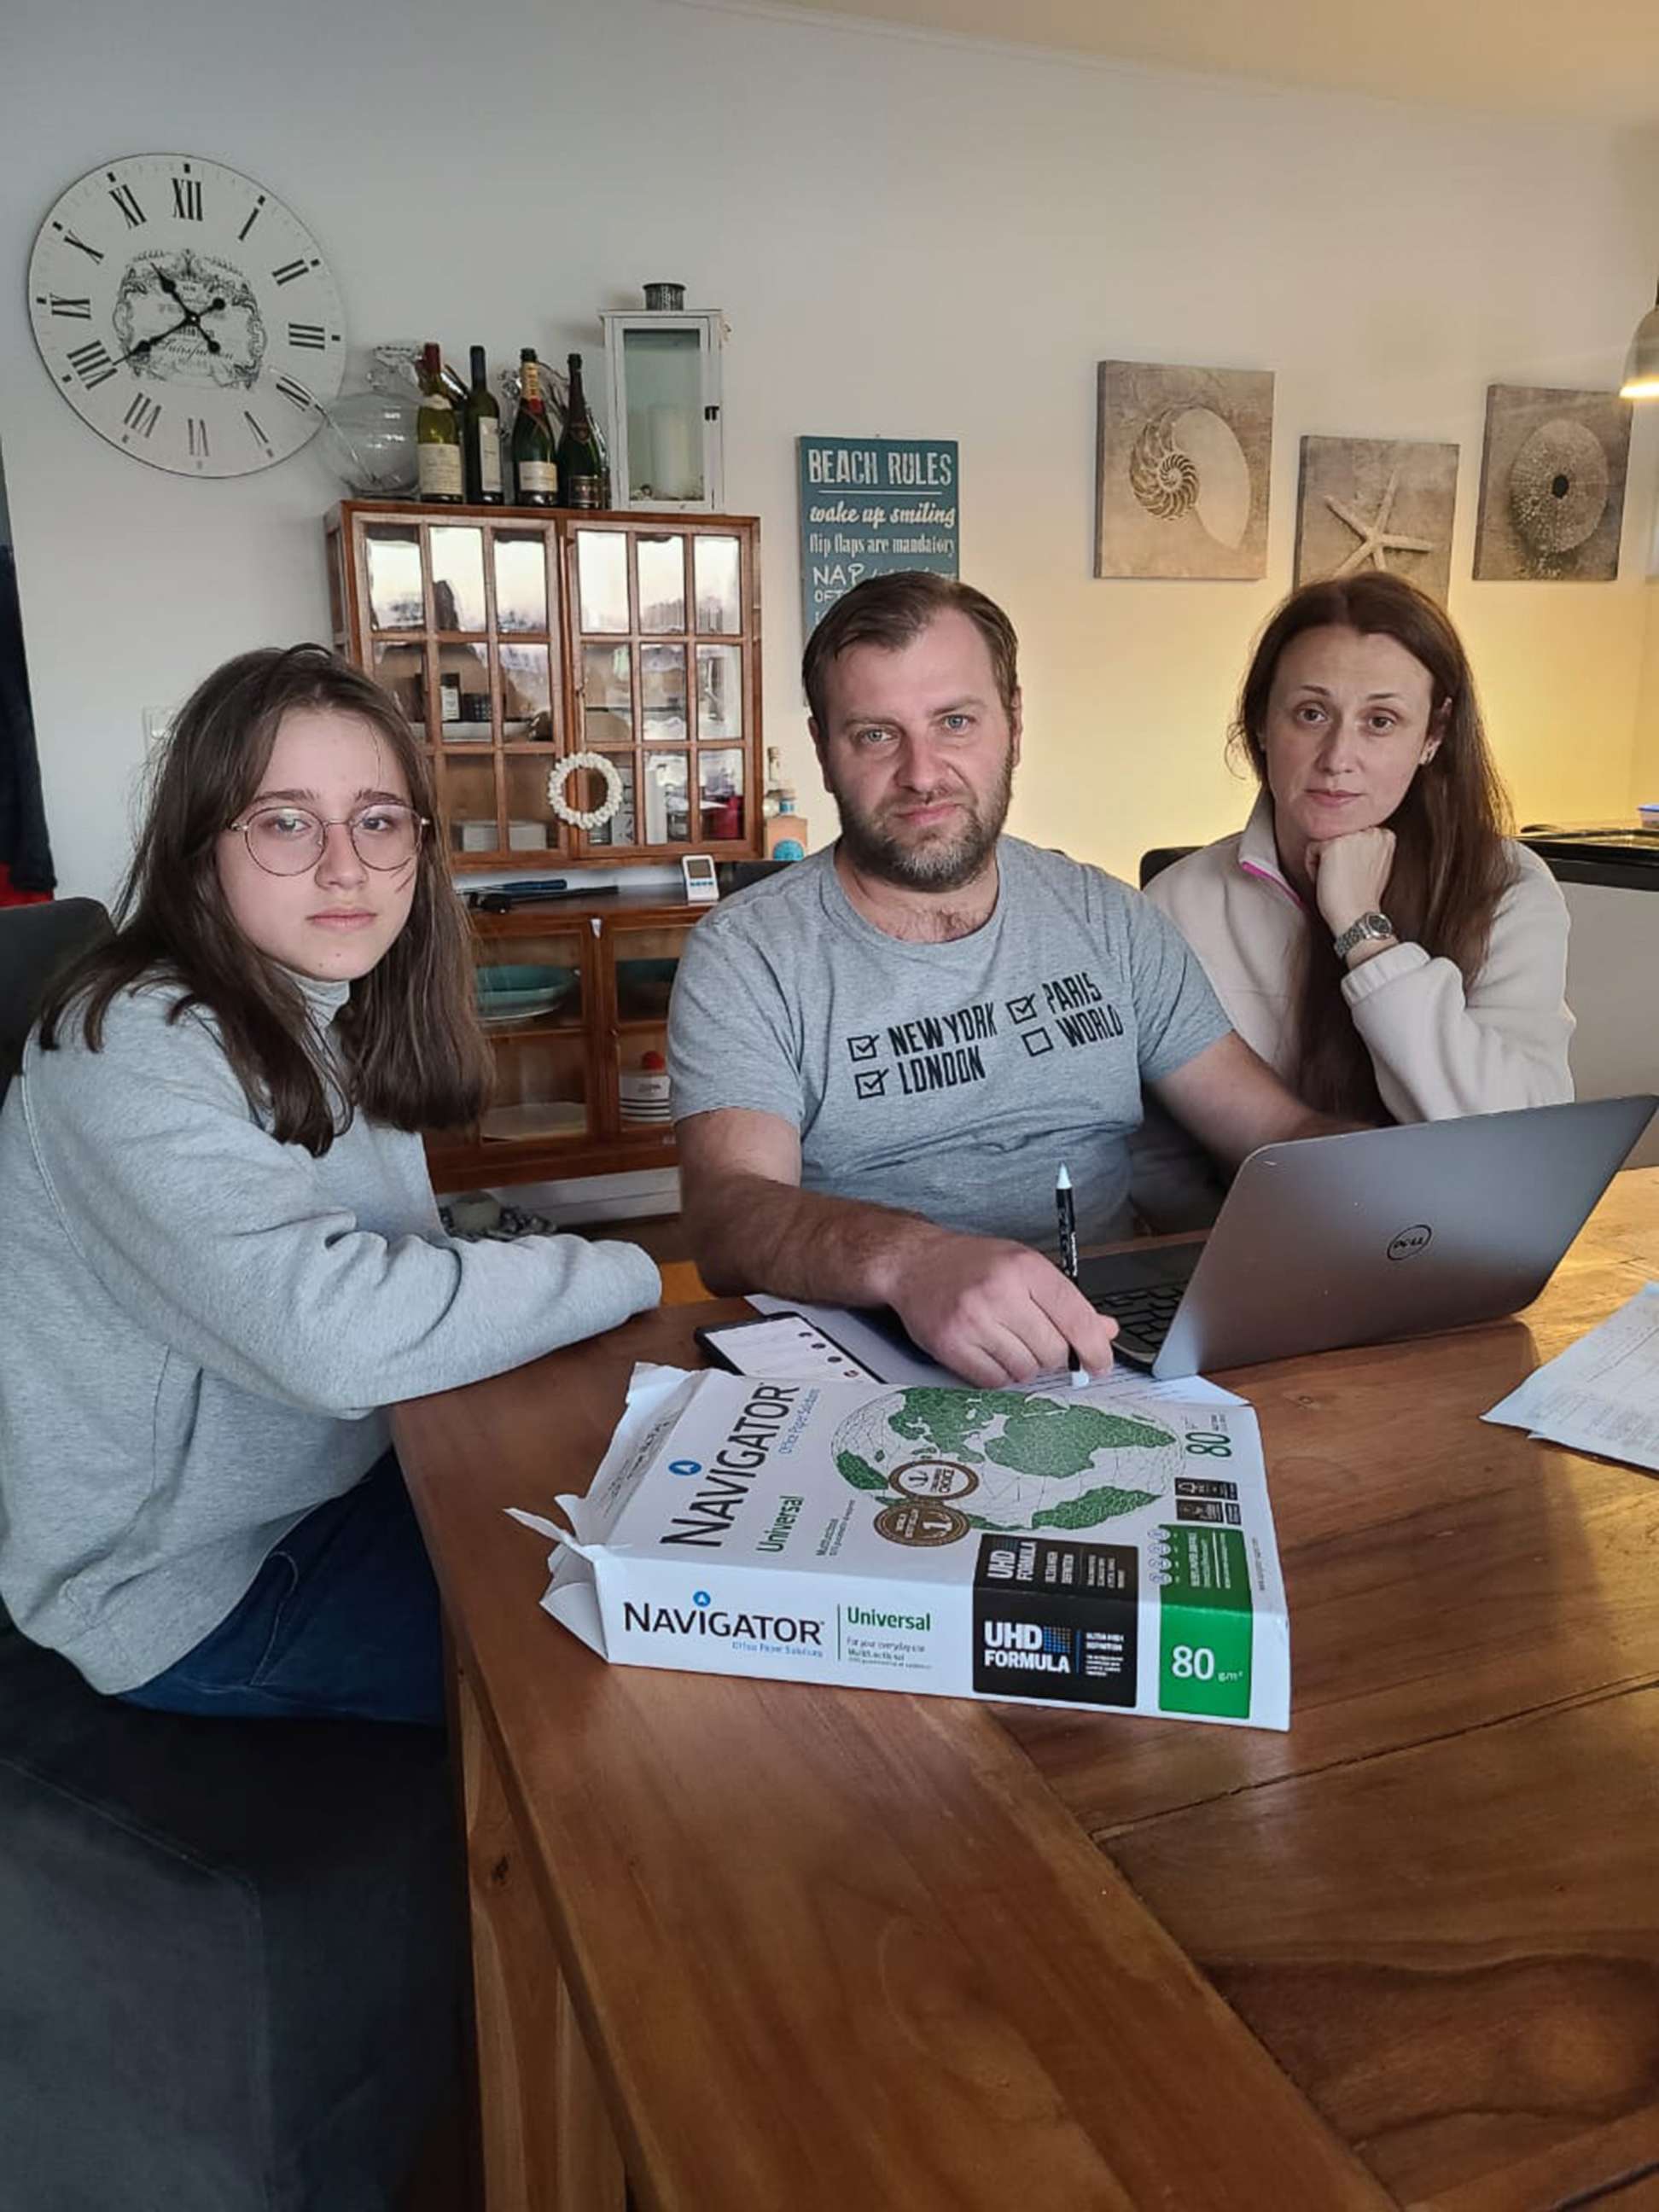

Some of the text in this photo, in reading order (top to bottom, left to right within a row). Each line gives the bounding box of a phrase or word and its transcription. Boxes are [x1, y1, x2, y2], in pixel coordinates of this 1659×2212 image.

[108, 184, 147, 229] XI
[172, 178, 204, 221] XII
[64, 230, 104, 264] X
[272, 259, 309, 286] II
[49, 293, 91, 319] IX
[288, 323, 326, 351] III
[123, 392, 162, 439] VII
[187, 417, 209, 457] VI
[808, 449, 952, 486] BEACH RULES
[810, 500, 956, 529] wake up smiling
[810, 533, 831, 559] flip
[866, 538, 889, 554] are
[893, 533, 956, 559] mandatory
[812, 563, 865, 586] NAP
[1042, 972, 1103, 1015] PARIS
[1055, 1004, 1124, 1048] WORLD
[897, 1045, 986, 1095] LONDON
[1185, 1431, 1232, 1458] 80
[660, 1382, 800, 1548] NAVIGATOR
[755, 1495, 805, 1552] Universal
[987, 1549, 1016, 1580] UHD
[623, 1602, 823, 1646] NAVIGATOR
[847, 1605, 932, 1632] Universal
[984, 1620, 1043, 1651] UHD
[984, 1650, 1072, 1674] FORMULA
[1172, 1644, 1215, 1681] 80
